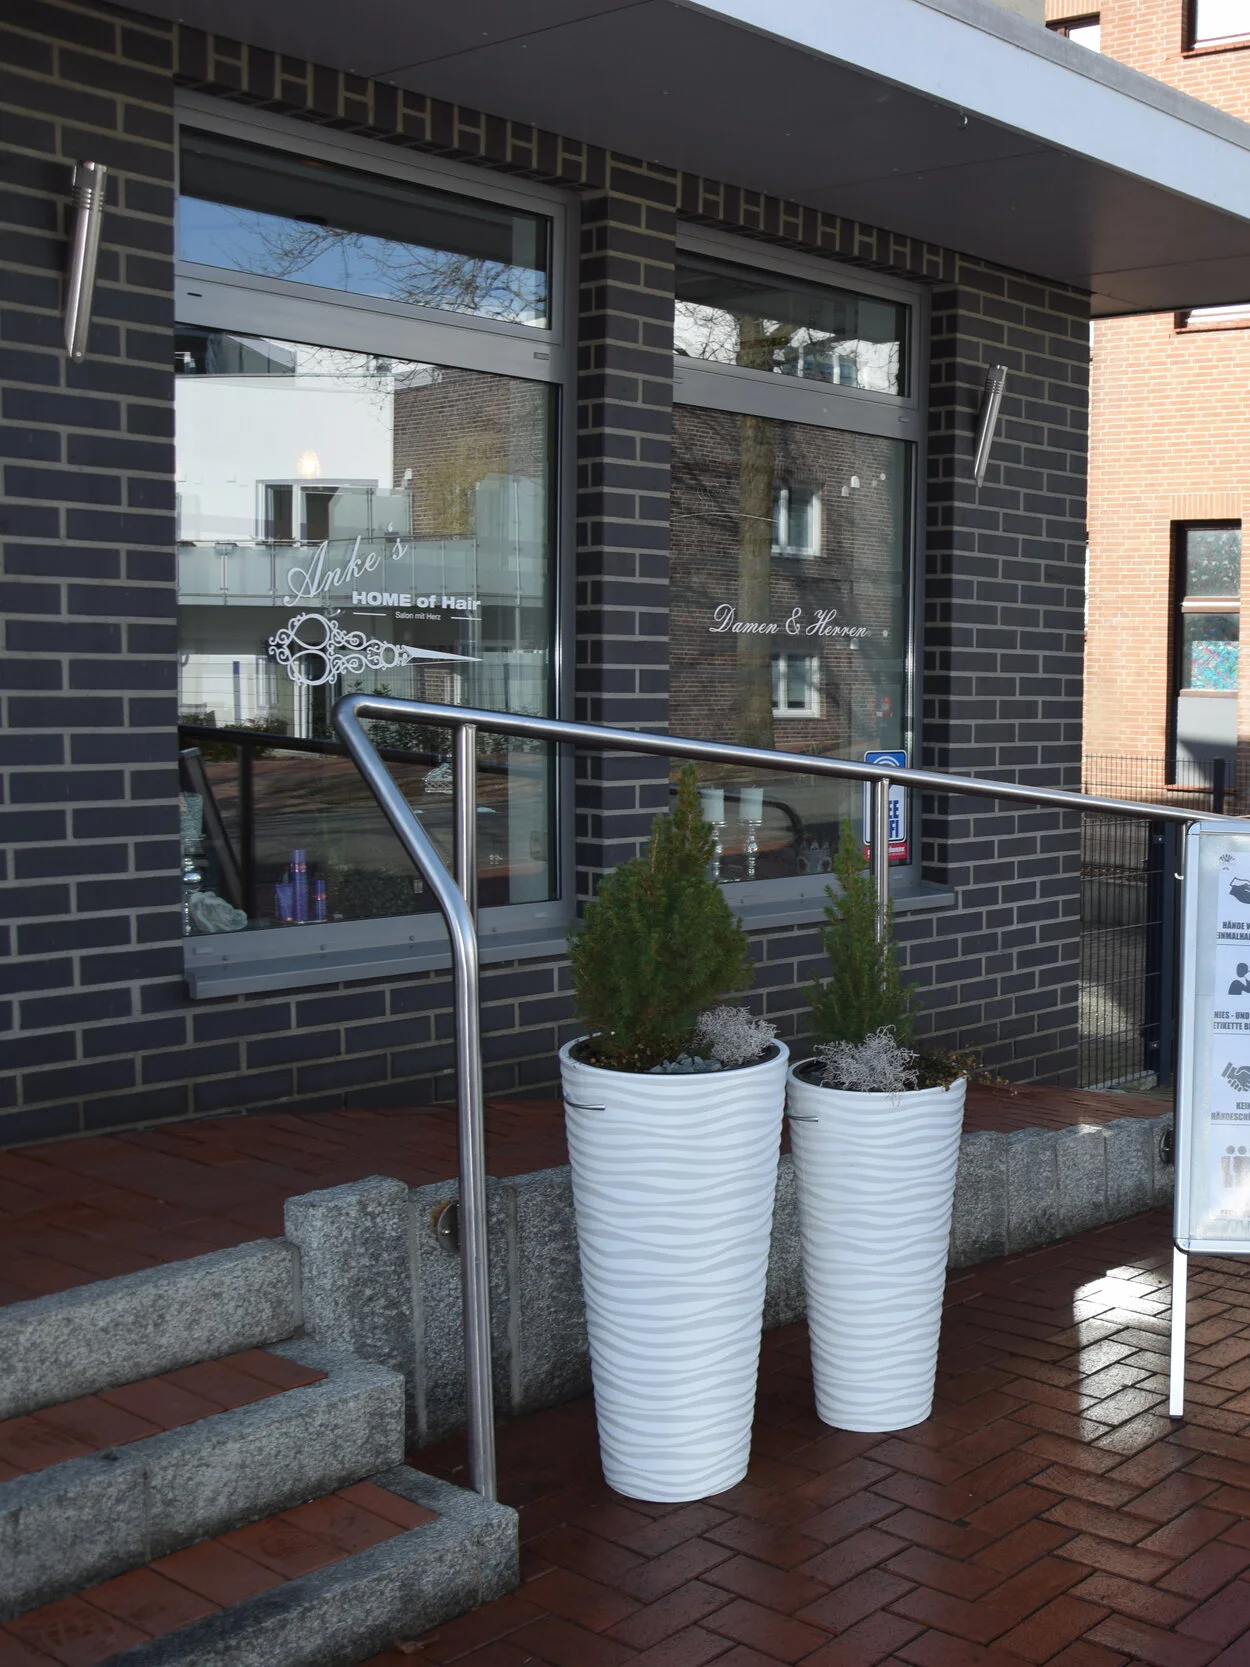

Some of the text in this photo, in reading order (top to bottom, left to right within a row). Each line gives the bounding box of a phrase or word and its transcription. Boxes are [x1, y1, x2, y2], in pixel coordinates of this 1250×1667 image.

[352, 590, 481, 610] HOME of Hair
[395, 611, 441, 621] Salon mit Herz
[709, 603, 868, 638] Damen & Herren
[1222, 920, 1245, 930] HÄNDE
[1235, 1011, 1250, 1020] UND
